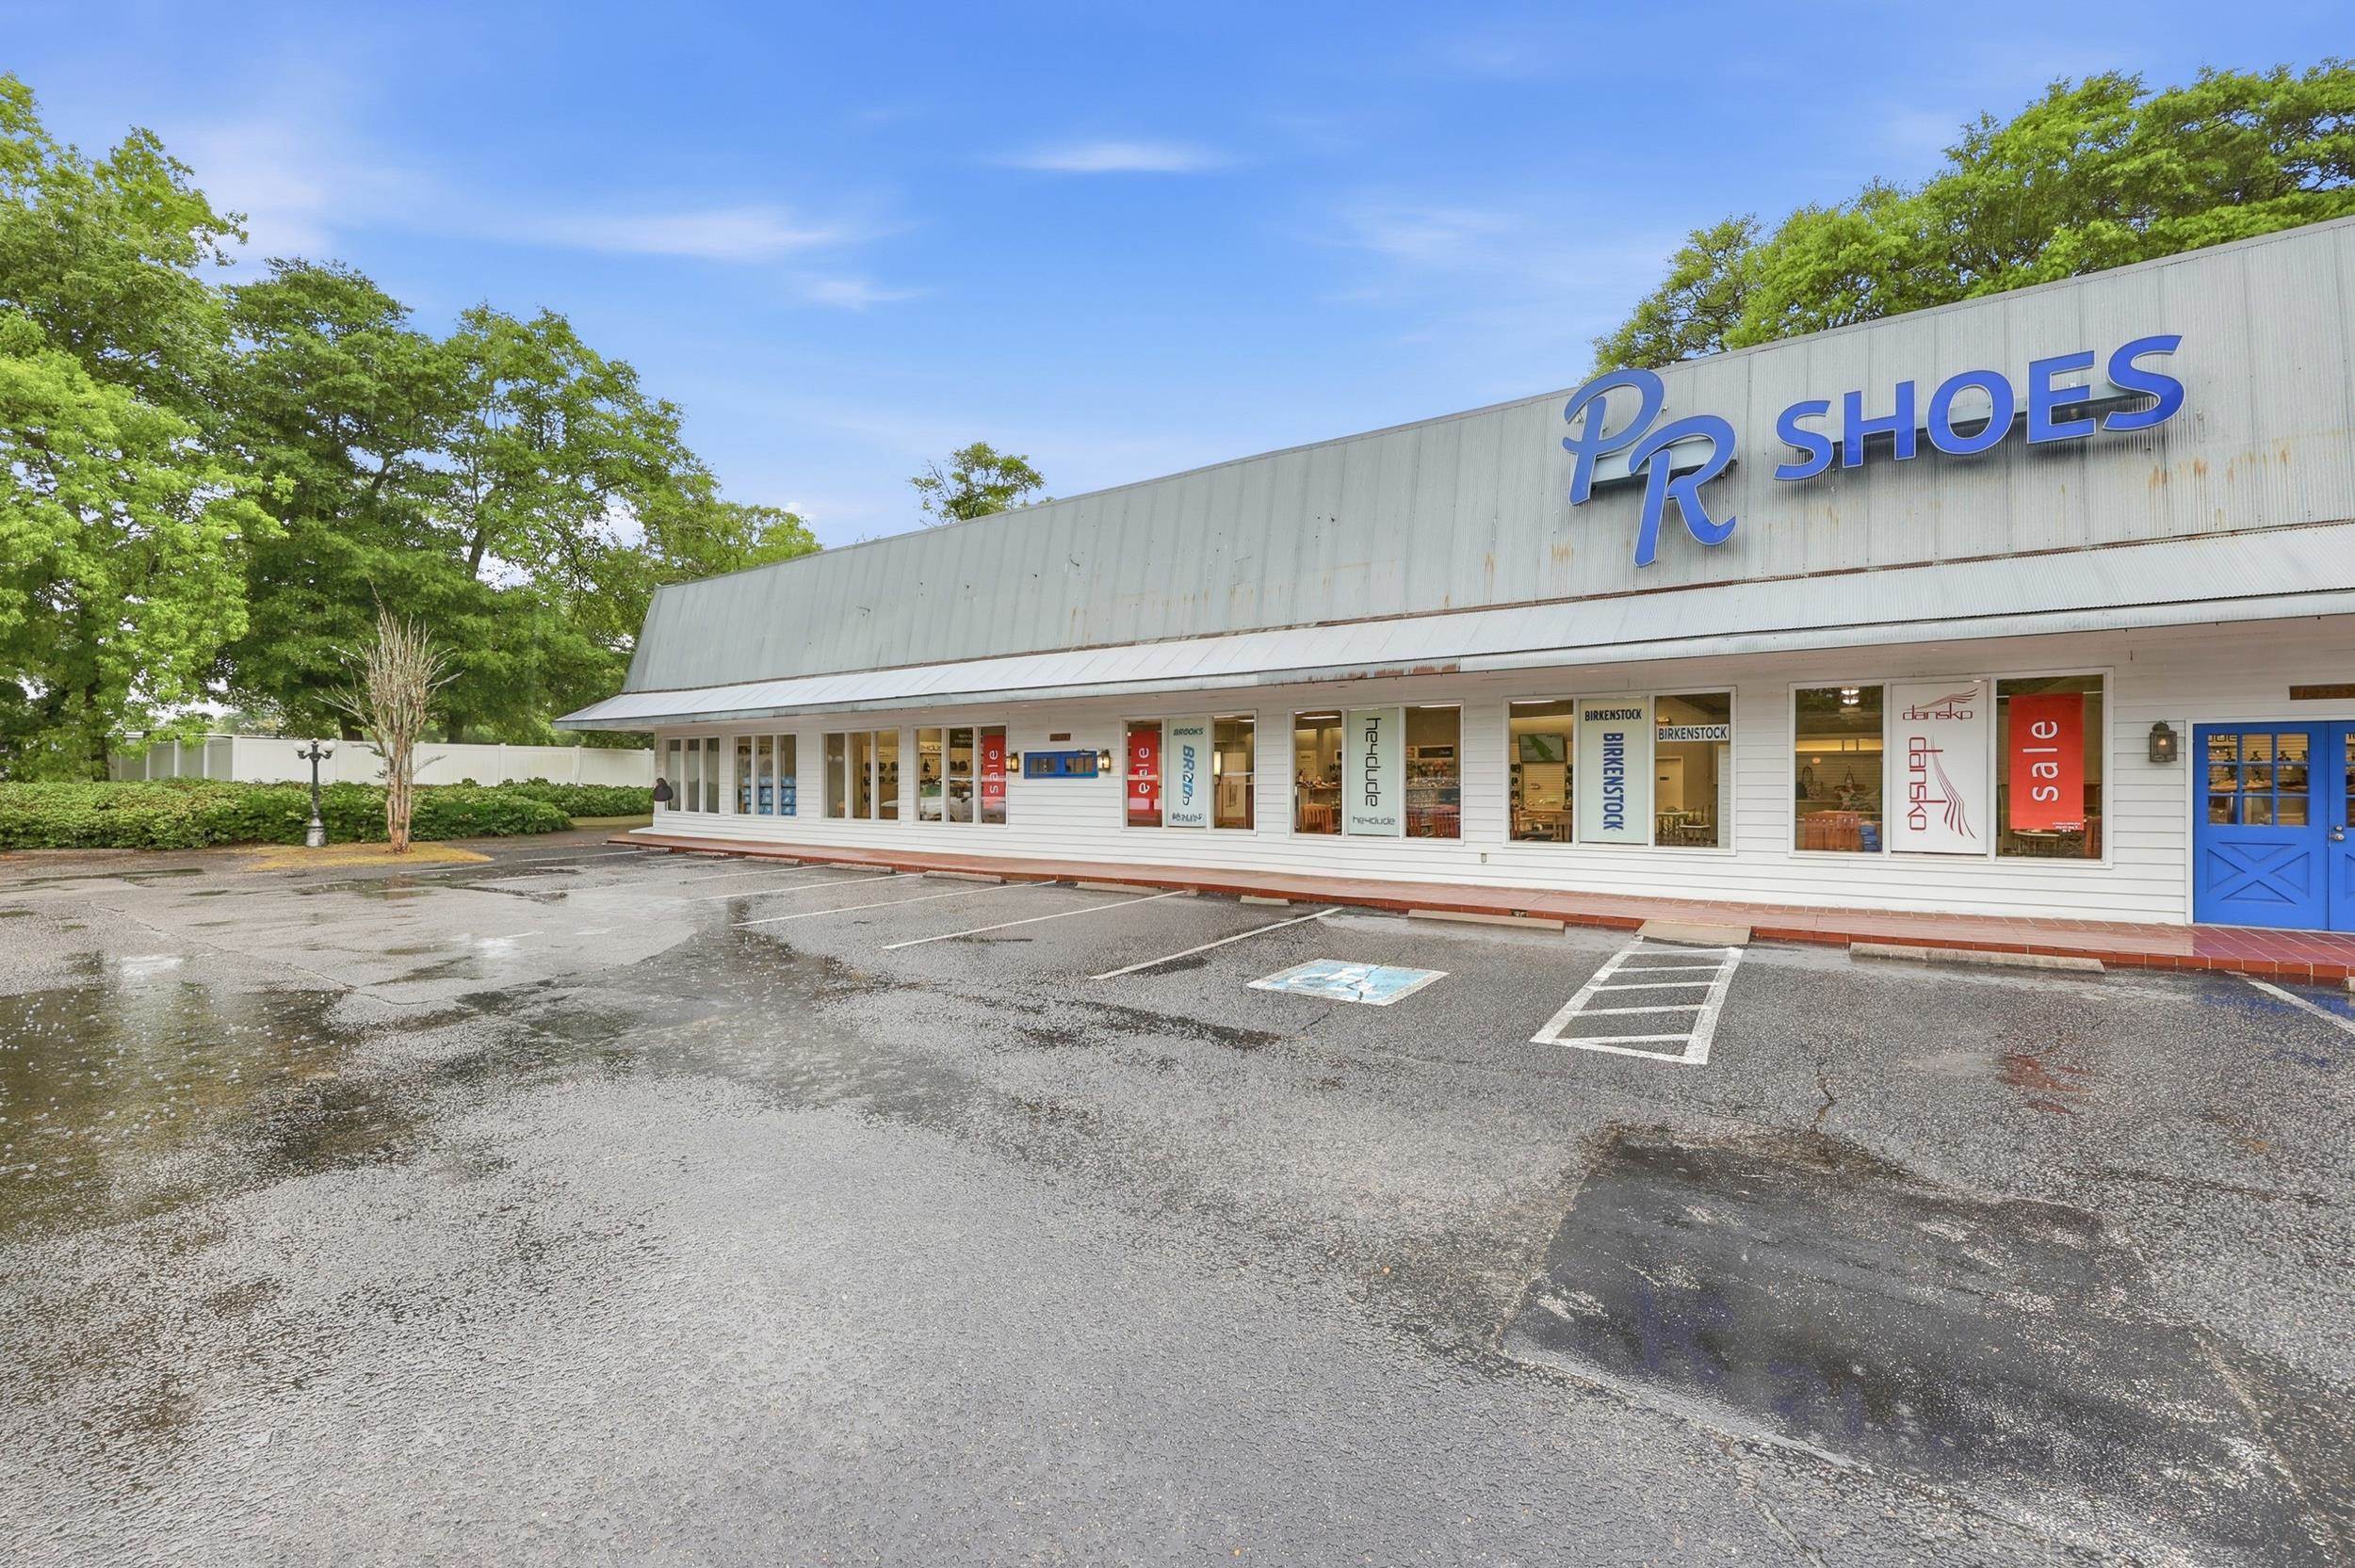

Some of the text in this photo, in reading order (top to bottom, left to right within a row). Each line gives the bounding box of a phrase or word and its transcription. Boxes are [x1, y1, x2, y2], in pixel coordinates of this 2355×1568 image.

[1562, 334, 2185, 568] PR SHOES
[1174, 727, 1203, 736] BROOKS
[1584, 708, 1642, 721] BIRKENSTOCK
[1658, 726, 1727, 740] BIRKENSTOCK
[1902, 702, 1973, 721] dansko
[987, 750, 999, 794] sale
[1366, 717, 1382, 807] heydude
[1602, 733, 1624, 831] BIRKENSTOCK
[2022, 720, 2058, 802] sale
[1907, 736, 1947, 831] dansko
[1353, 816, 1395, 825] heydude
